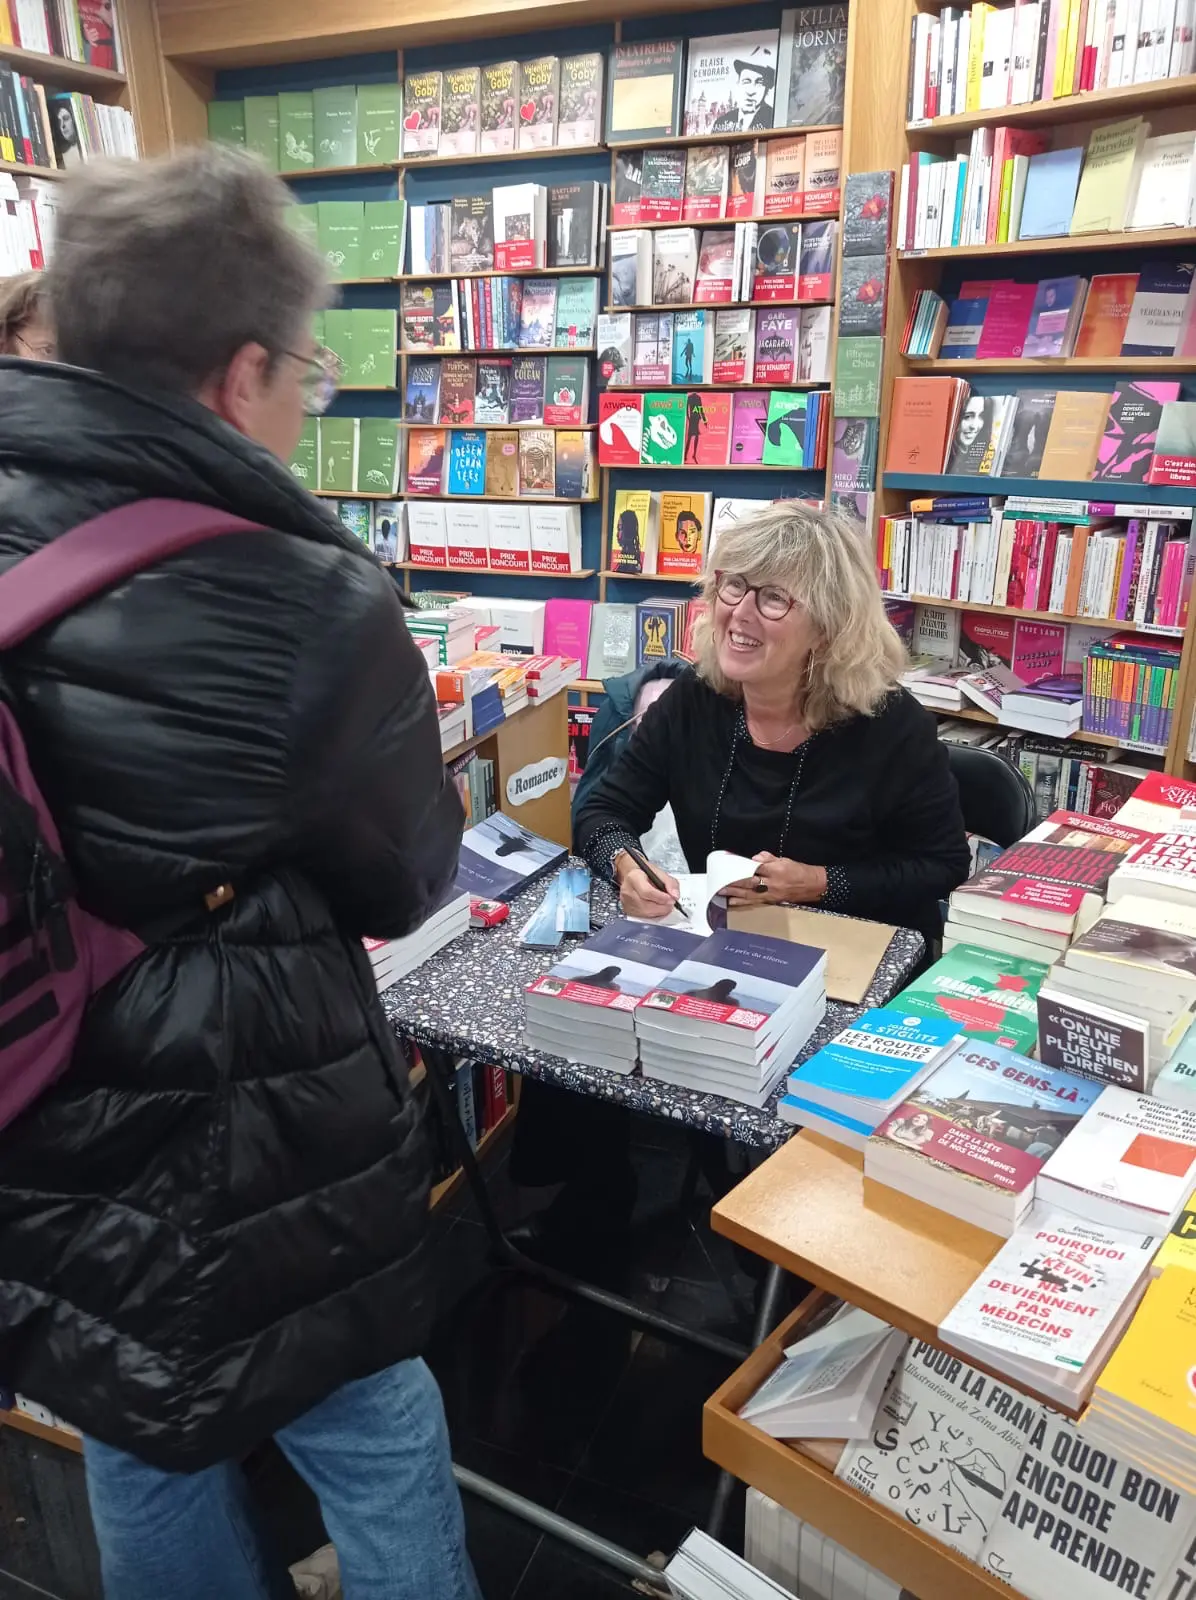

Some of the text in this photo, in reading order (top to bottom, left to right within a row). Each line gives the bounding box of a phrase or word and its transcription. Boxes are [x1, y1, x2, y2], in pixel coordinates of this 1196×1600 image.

[524, 63, 552, 74] Valentine
[565, 59, 597, 69] Valentine
[700, 57, 724, 67] BLAISE
[447, 73, 476, 84] Valentine
[485, 69, 513, 79] Valentine
[529, 72, 552, 84] Goby
[570, 68, 596, 80] Goby
[410, 76, 437, 86] Valentine
[490, 78, 513, 89] Goby
[414, 85, 437, 97] Goby
[452, 82, 476, 94] Goby
[734, 155, 751, 168] LOUP
[768, 312, 787, 320] GAËL
[761, 320, 793, 331] FAYE
[767, 363, 791, 371] RENAUDOT
[514, 369, 540, 380] COLGAN
[1170, 473, 1191, 481] libres
[833, 480, 864, 489] ARIKAWA
[411, 554, 445, 564] GONCOURT
[449, 556, 487, 565] GONCOURT
[458, 550, 474, 558] PRIX
[500, 552, 516, 560] PRIX
[541, 555, 557, 563] PRIX
[490, 558, 528, 568] GONCOURT
[532, 561, 569, 571] GONCOURT
[929, 610, 946, 621] SUFFIT
[1020, 625, 1037, 634] ROSE
[1040, 628, 1061, 638] LAMY
[515, 766, 559, 795] Romance
[988, 853, 1109, 884] LOGOCRATIE
[734, 948, 750, 957] prix
[762, 954, 789, 966] silence
[861, 1022, 939, 1043] E. STIGLITZ
[1094, 1027, 1121, 1047] NE
[839, 1037, 856, 1046] DE
[857, 1041, 873, 1050] LA
[845, 1031, 933, 1055] LES ROUTES
[1067, 1030, 1116, 1054] PEUT
[1045, 1034, 1139, 1076] PLUS RIEN
[1137, 1097, 1179, 1112] Philippe
[1139, 1104, 1172, 1117] Céline
[1098, 1111, 1156, 1132] destruction
[1125, 1113, 1138, 1121] Le
[1140, 1118, 1180, 1132] pouvoir
[1145, 1112, 1178, 1125] Simon
[943, 1132, 955, 1143] ET
[956, 1137, 966, 1147] LE
[948, 1127, 970, 1140] DANS
[970, 1135, 982, 1145] LA
[937, 1138, 1017, 1175] DE NOS CAMPAGNES
[1035, 1231, 1125, 1261] POURQUOI
[1058, 1248, 1087, 1263] LES
[1037, 1280, 1061, 1294] NE
[988, 1279, 1099, 1318] DEVIENNENT
[1015, 1301, 1052, 1318] PAS
[979, 1303, 1074, 1339] MÉDECINS
[912, 1339, 962, 1385] POUR
[960, 1371, 986, 1401] LA
[904, 1362, 956, 1404] Illustrations
[956, 1400, 969, 1412] de
[968, 1406, 998, 1432] Zeina
[928, 1411, 946, 1433] Y
[1029, 1413, 1180, 1523] À QUOI BON
[850, 1467, 876, 1490] TRACTS
[1016, 1452, 1116, 1534] ENCORE
[1002, 1490, 1156, 1600] APPRENDRE
